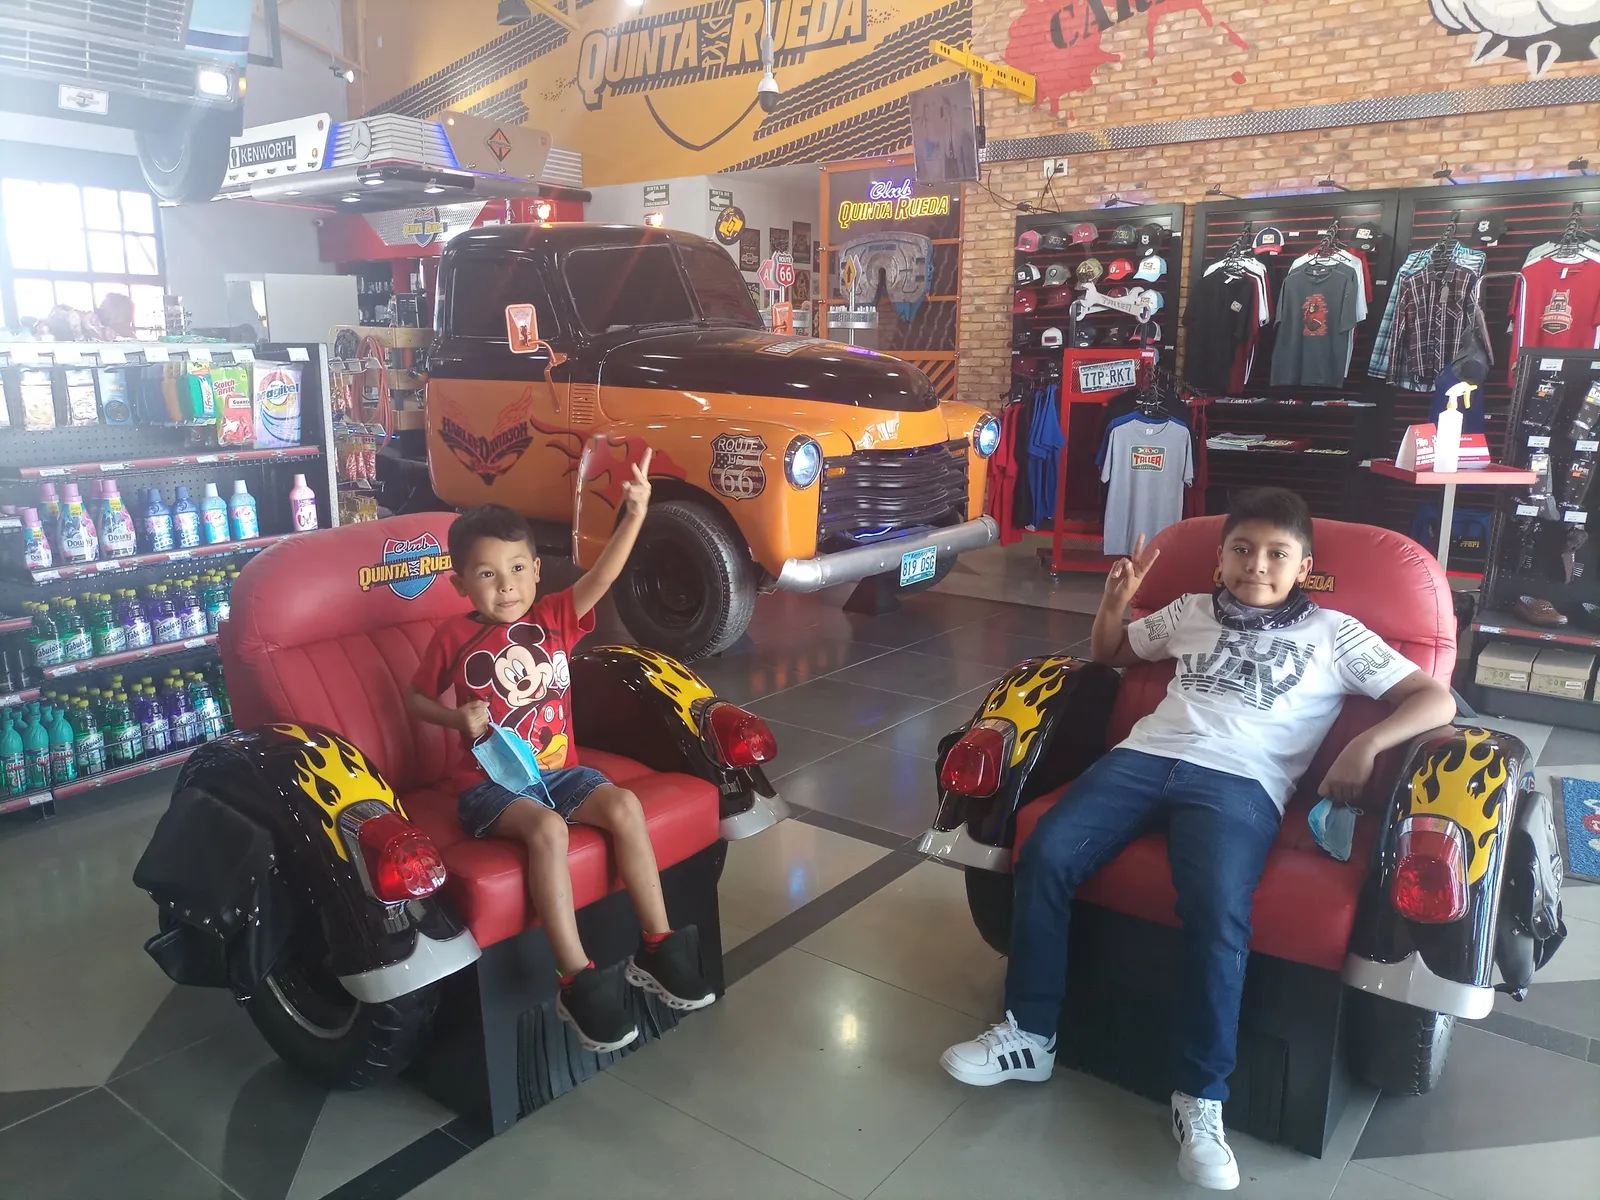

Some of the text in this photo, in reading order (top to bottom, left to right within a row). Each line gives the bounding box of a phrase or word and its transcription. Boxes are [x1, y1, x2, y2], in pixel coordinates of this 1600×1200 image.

[577, 18, 700, 110] QUINTA
[726, 0, 866, 66] RUEDA
[240, 140, 295, 164] KENWORTH
[869, 178, 912, 200] Club
[838, 195, 951, 229] QUINTA RUEDA
[780, 266, 792, 282] 66
[213, 379, 235, 392] Scotch
[1082, 371, 1105, 387] 77P
[1109, 367, 1132, 384] RK7
[218, 386, 235, 396] Brite
[717, 438, 758, 452] ROUTE
[1133, 454, 1163, 468] TALLER
[719, 466, 754, 495] 66
[393, 537, 430, 554] Club
[358, 555, 452, 592] QUINTA RUED
[903, 560, 917, 577] 819
[920, 555, 935, 572] DSG
[1214, 627, 1316, 677] RUN
[1181, 653, 1302, 710] WAY
